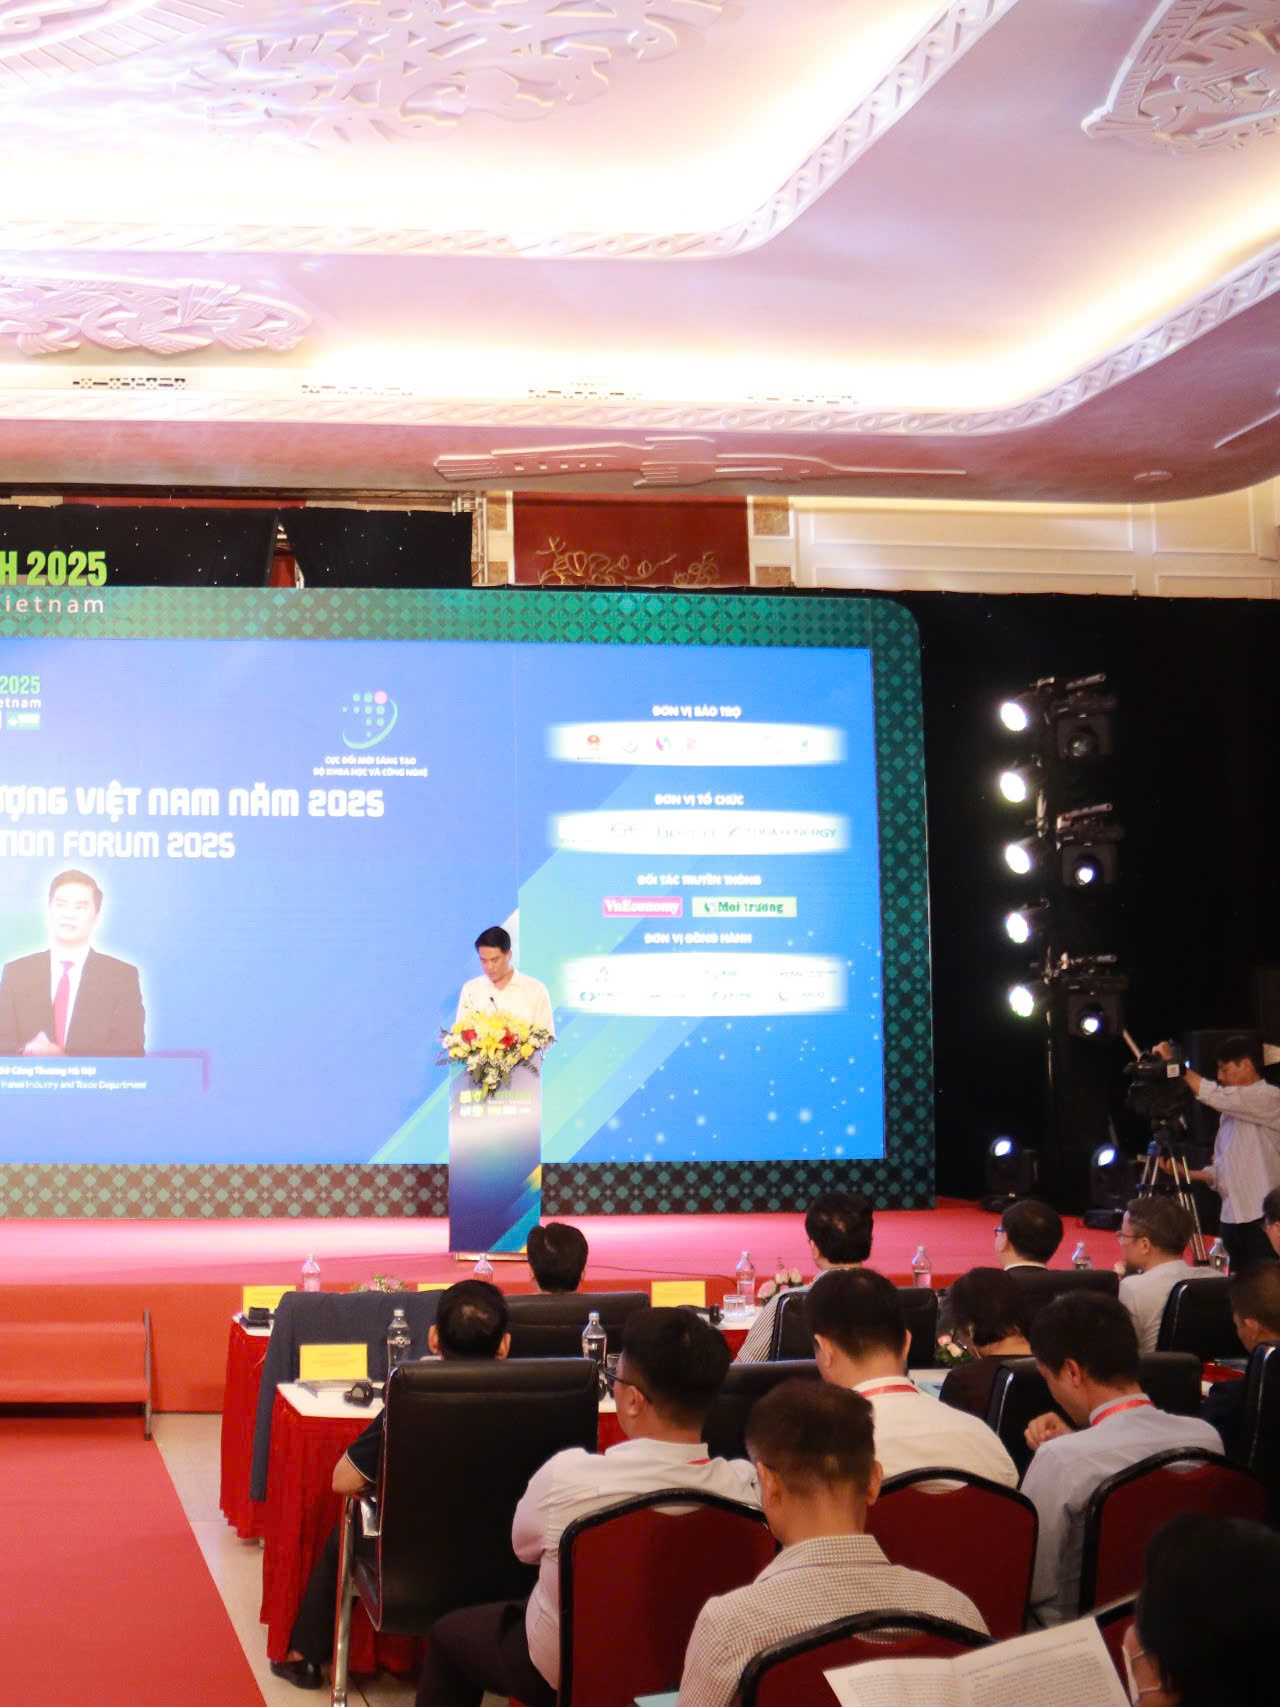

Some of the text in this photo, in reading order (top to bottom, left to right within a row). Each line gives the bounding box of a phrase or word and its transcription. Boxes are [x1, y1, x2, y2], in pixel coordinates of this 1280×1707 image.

[26, 550, 108, 586] 2025
[76, 780, 142, 823] VIỆT
[148, 788, 220, 816] NAM
[228, 781, 300, 817] NĂM
[308, 788, 385, 817] 2025
[63, 831, 160, 858] FORUM
[167, 831, 236, 858] 2025
[605, 899, 679, 915] VnEconomy
